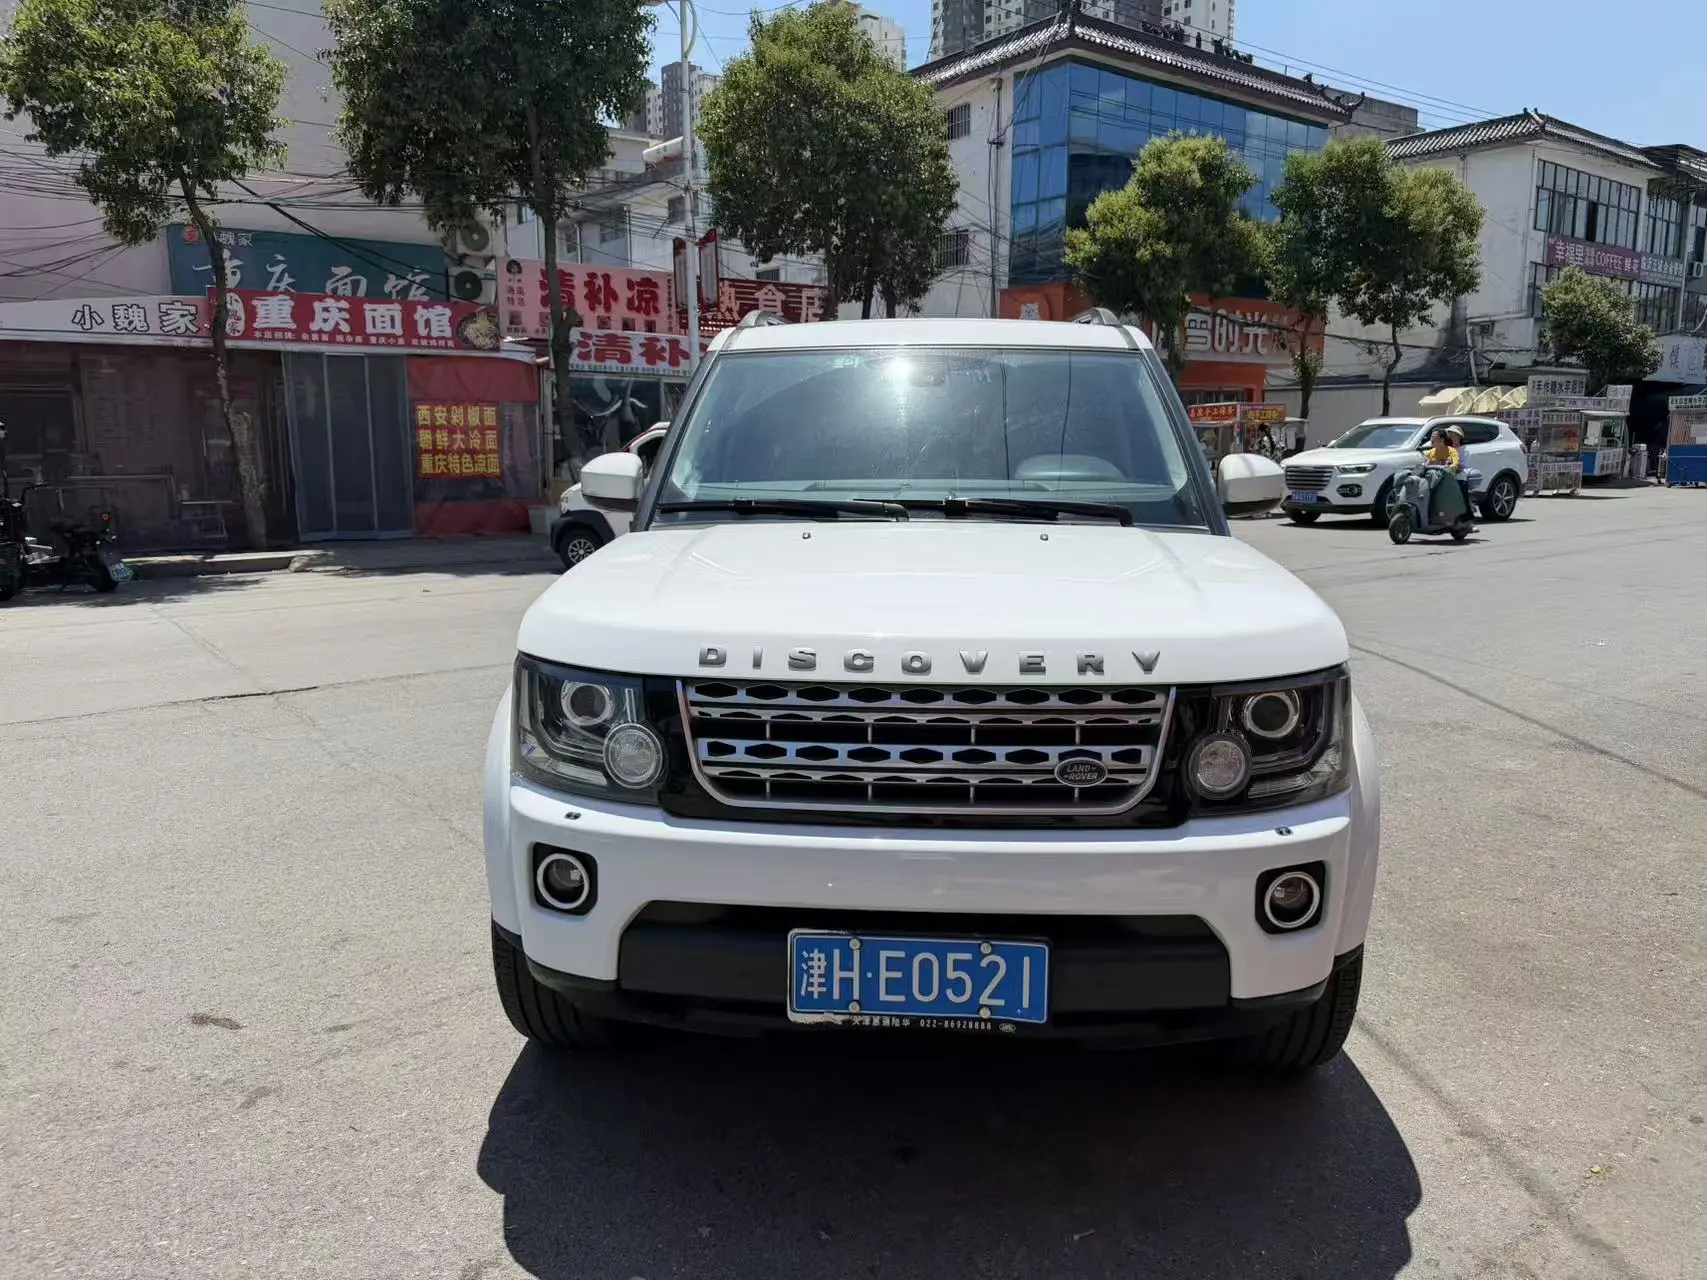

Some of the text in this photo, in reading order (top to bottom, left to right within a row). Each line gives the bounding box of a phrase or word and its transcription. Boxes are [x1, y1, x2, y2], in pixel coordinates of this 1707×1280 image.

[1555, 239, 1584, 266] 幸福里
[1596, 251, 1622, 270] COFFEE
[1624, 257, 1639, 274] 鲜花
[538, 267, 660, 316] 清补凉
[72, 301, 199, 336] 小魏家
[251, 295, 453, 338] 重庆面馆
[576, 331, 707, 368] 清补
[418, 429, 498, 451] 朝鲜大冷面
[420, 453, 500, 475] 重庆特色凉面
[699, 645, 1162, 676] DISCOVERY
[1067, 764, 1092, 773] LAND
[1069, 772, 1098, 780] ROVER
[919, 1020, 992, 1031] 022-86928888
